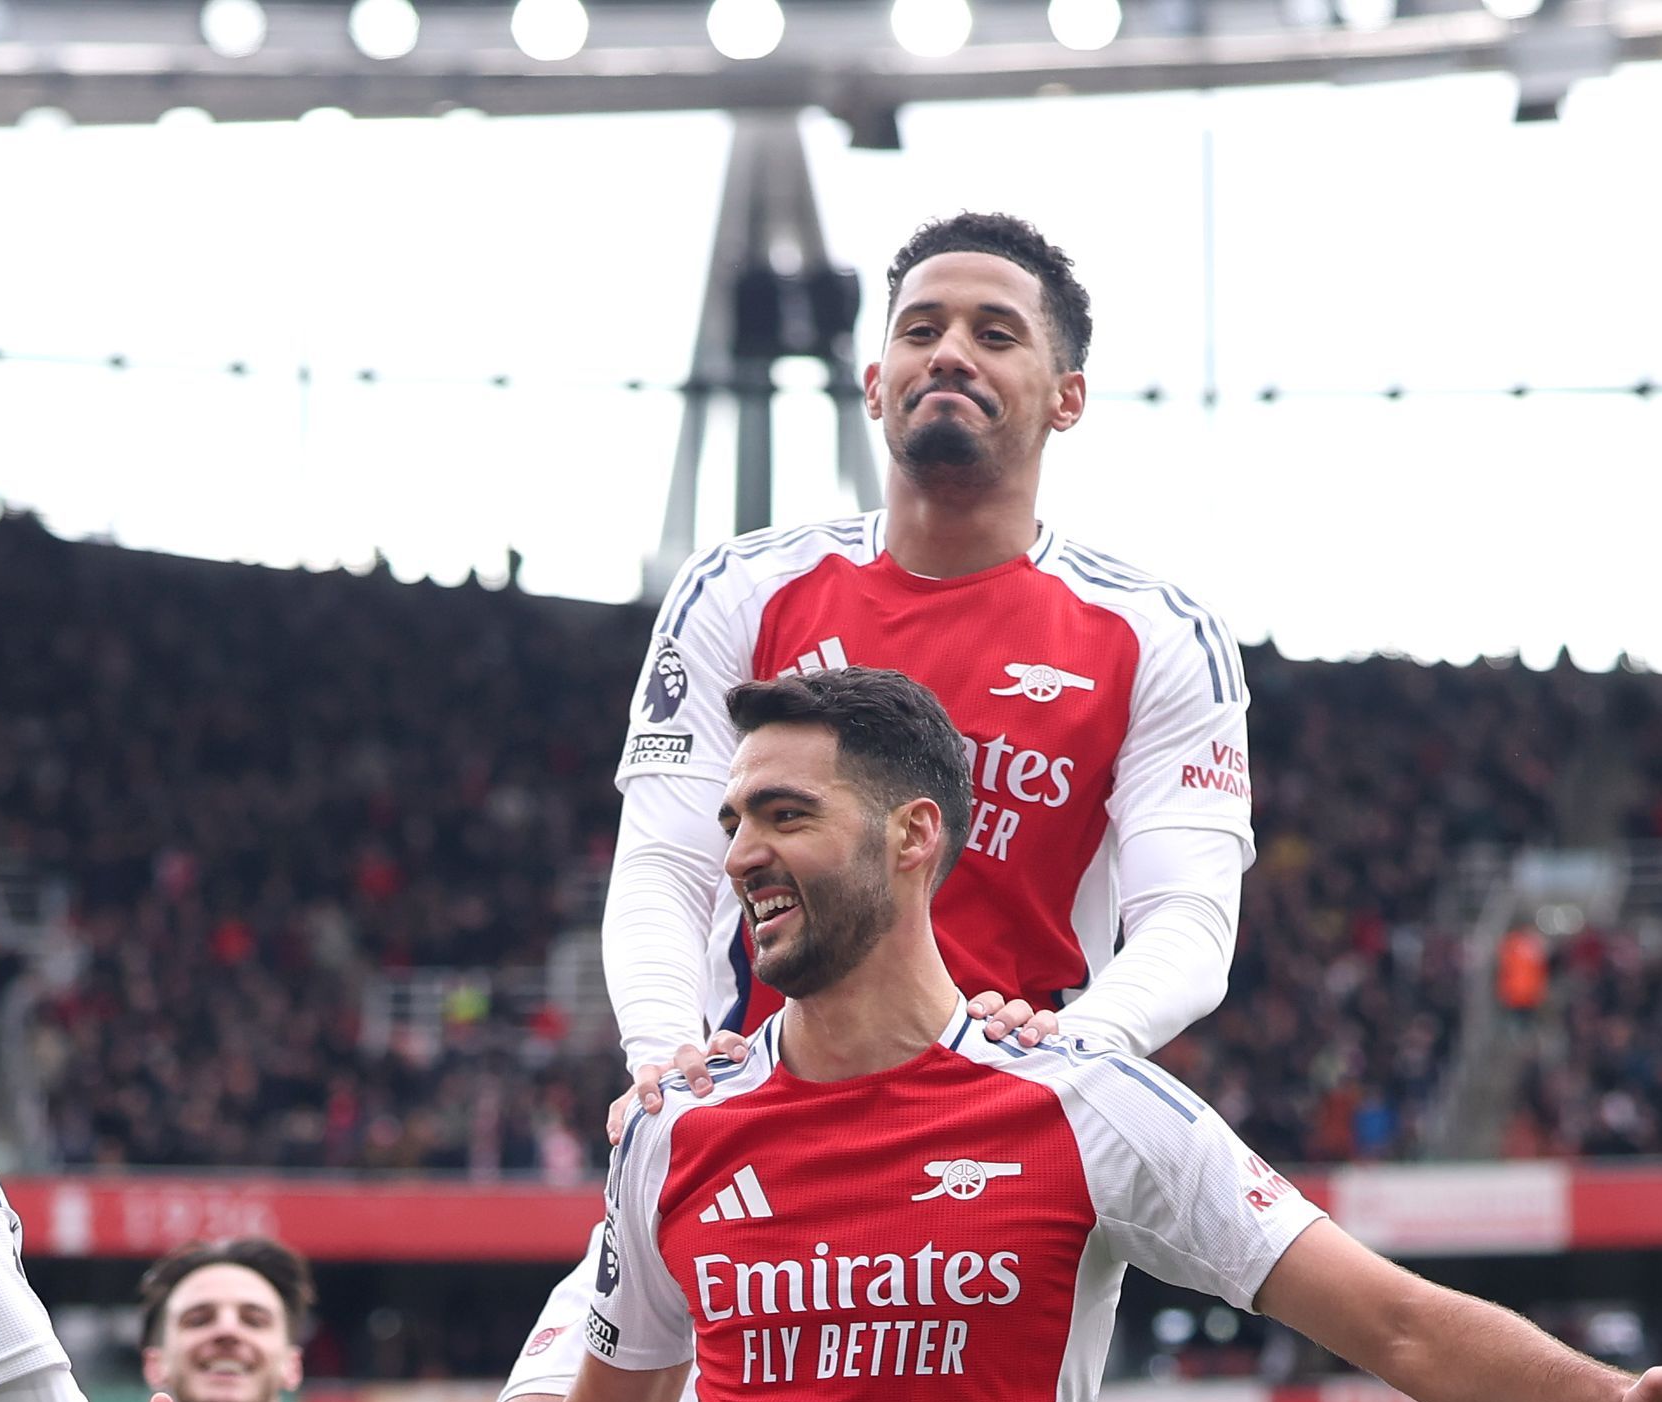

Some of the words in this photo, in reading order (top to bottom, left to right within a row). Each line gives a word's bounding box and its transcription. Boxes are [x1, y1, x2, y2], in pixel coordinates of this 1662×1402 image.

[638, 737, 686, 751] room
[1212, 741, 1247, 774] VIS
[1181, 765, 1252, 806] RWAN
[693, 1240, 1021, 1322] Emirates
[742, 1326, 801, 1384] FLY
[816, 1320, 968, 1379] BETTER
